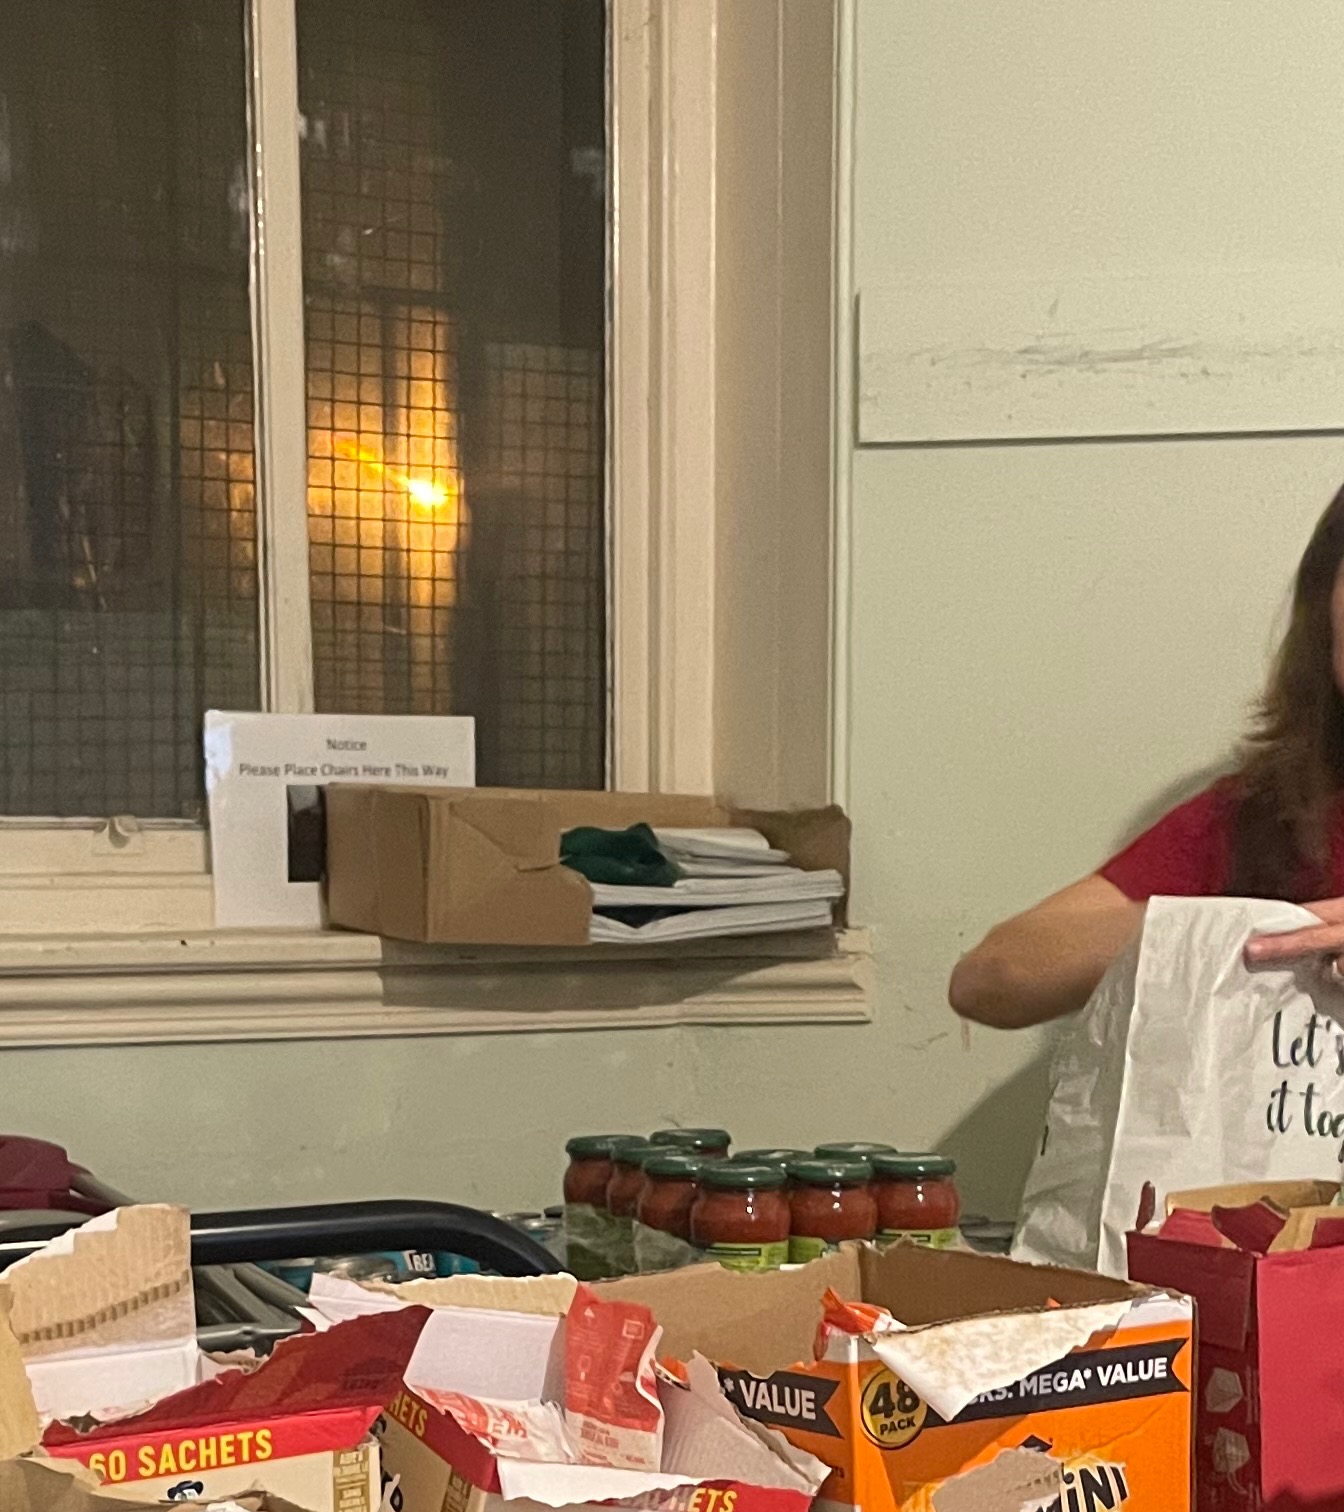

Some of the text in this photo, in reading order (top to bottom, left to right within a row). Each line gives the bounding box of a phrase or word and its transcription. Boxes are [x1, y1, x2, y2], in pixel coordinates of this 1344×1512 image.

[326, 738, 367, 750] Notice
[239, 763, 449, 779] Please Place Chairs Here This Way
[1267, 1080, 1292, 1134] it
[1096, 1356, 1168, 1393] VALUE
[739, 1379, 816, 1421] VALUE
[868, 1375, 920, 1418] 48
[879, 1416, 917, 1436] PACK
[89, 1429, 272, 1481] 60 SACHETS
